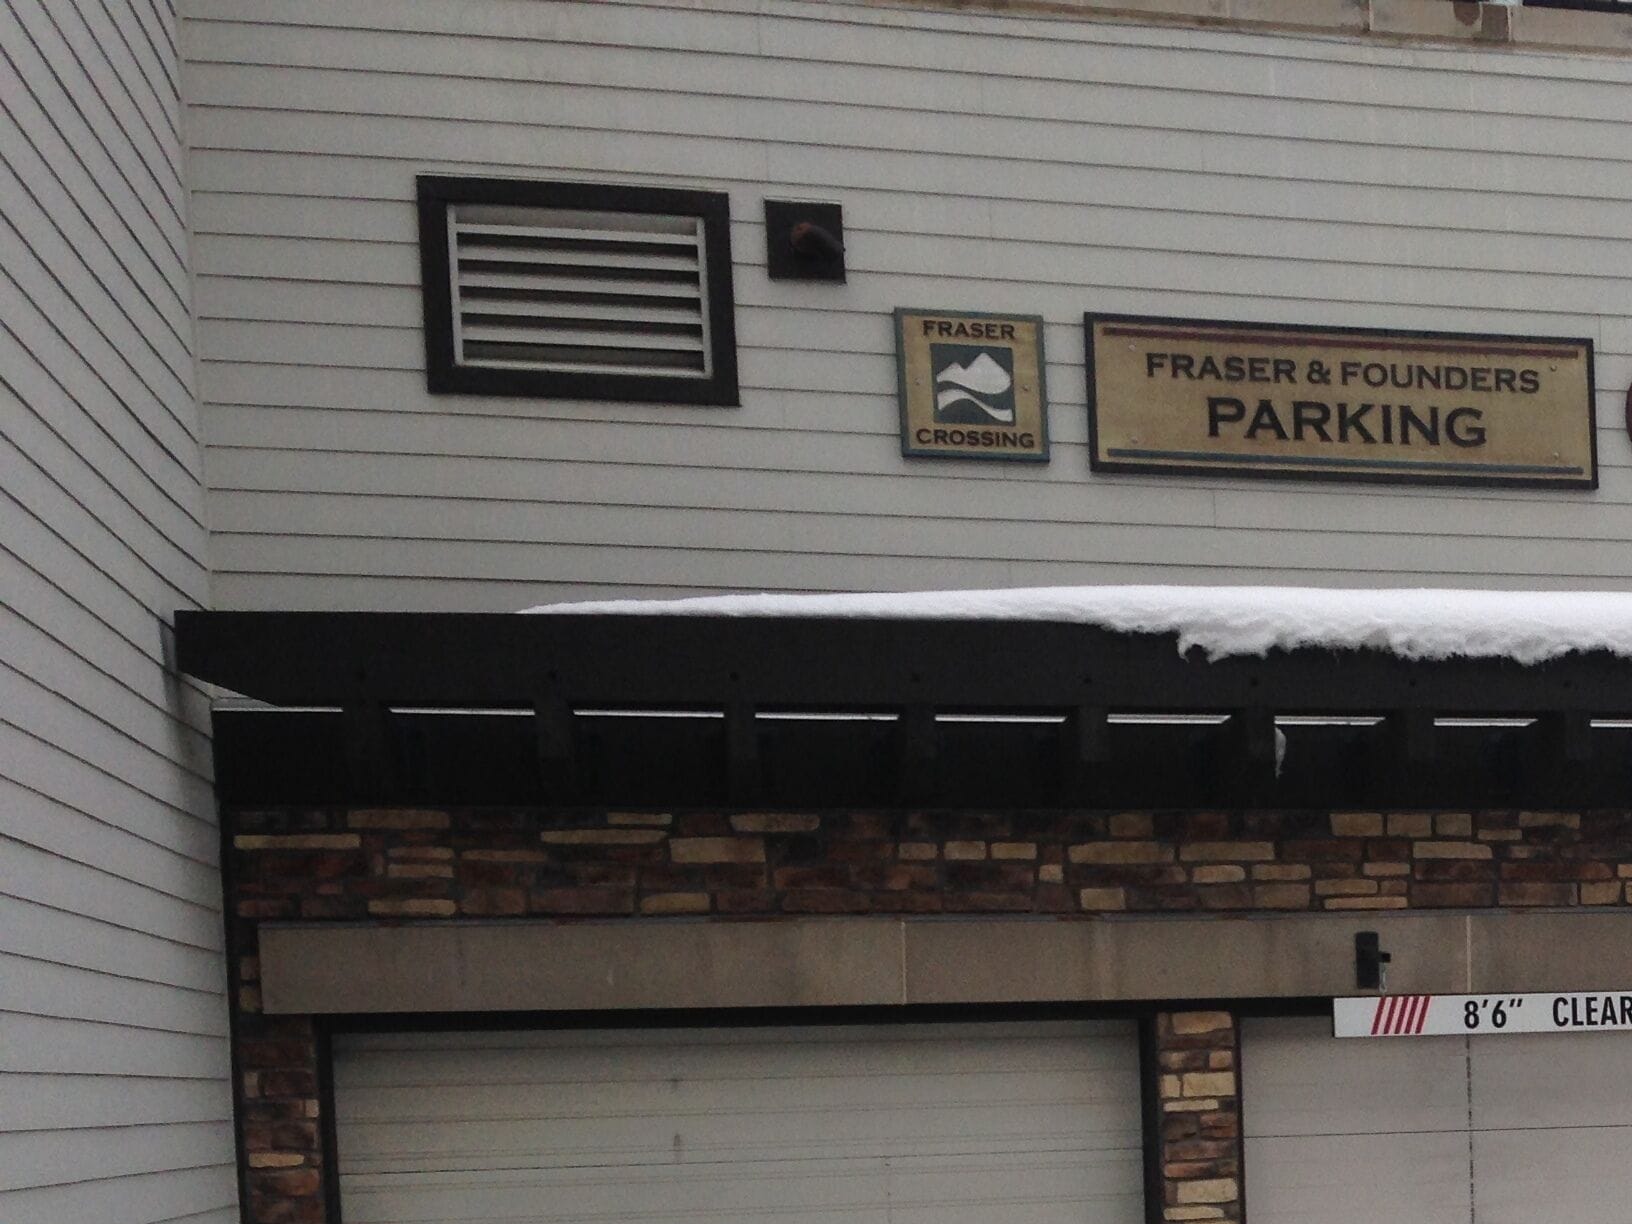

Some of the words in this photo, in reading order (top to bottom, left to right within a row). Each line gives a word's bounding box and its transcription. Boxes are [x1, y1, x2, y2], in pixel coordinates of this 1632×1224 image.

[922, 319, 1016, 340] FRASER
[1146, 352, 1297, 384] FRASER
[1306, 363, 1331, 386] &
[1340, 362, 1541, 394] FOUNDERS
[915, 428, 1035, 449] CROSSING
[1206, 397, 1487, 449] PARKING
